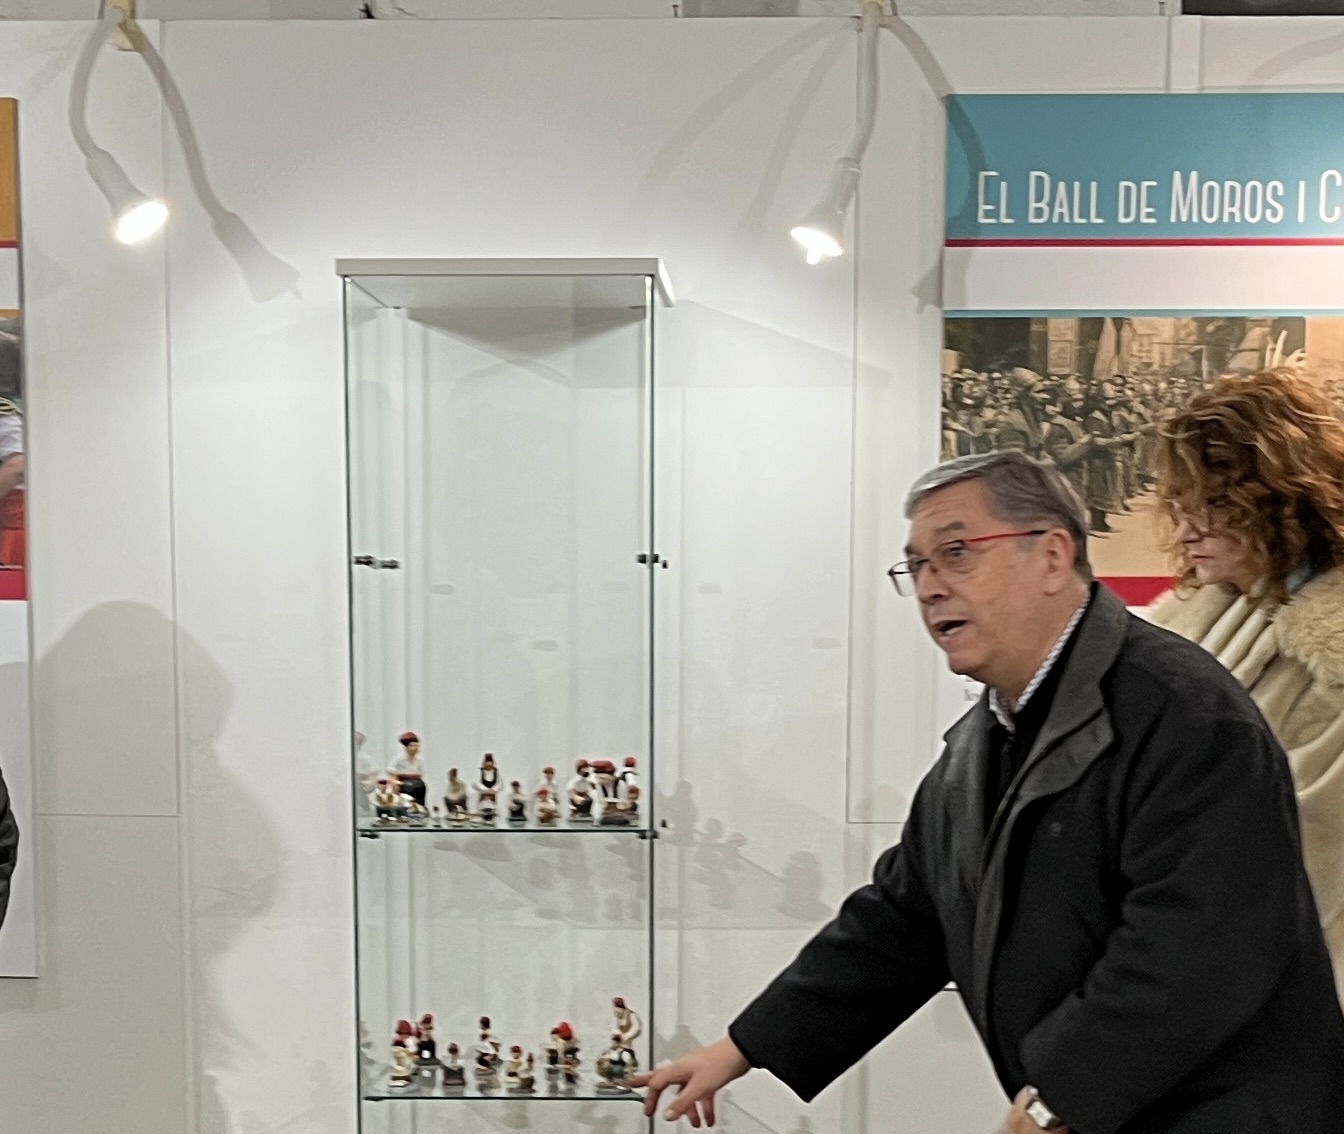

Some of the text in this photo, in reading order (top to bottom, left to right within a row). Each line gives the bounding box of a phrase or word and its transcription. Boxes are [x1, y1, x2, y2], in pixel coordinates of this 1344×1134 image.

[977, 170, 1015, 224] EL
[1028, 170, 1105, 224] BALL
[1117, 180, 1157, 224] DE
[1170, 170, 1284, 224] MOROS
